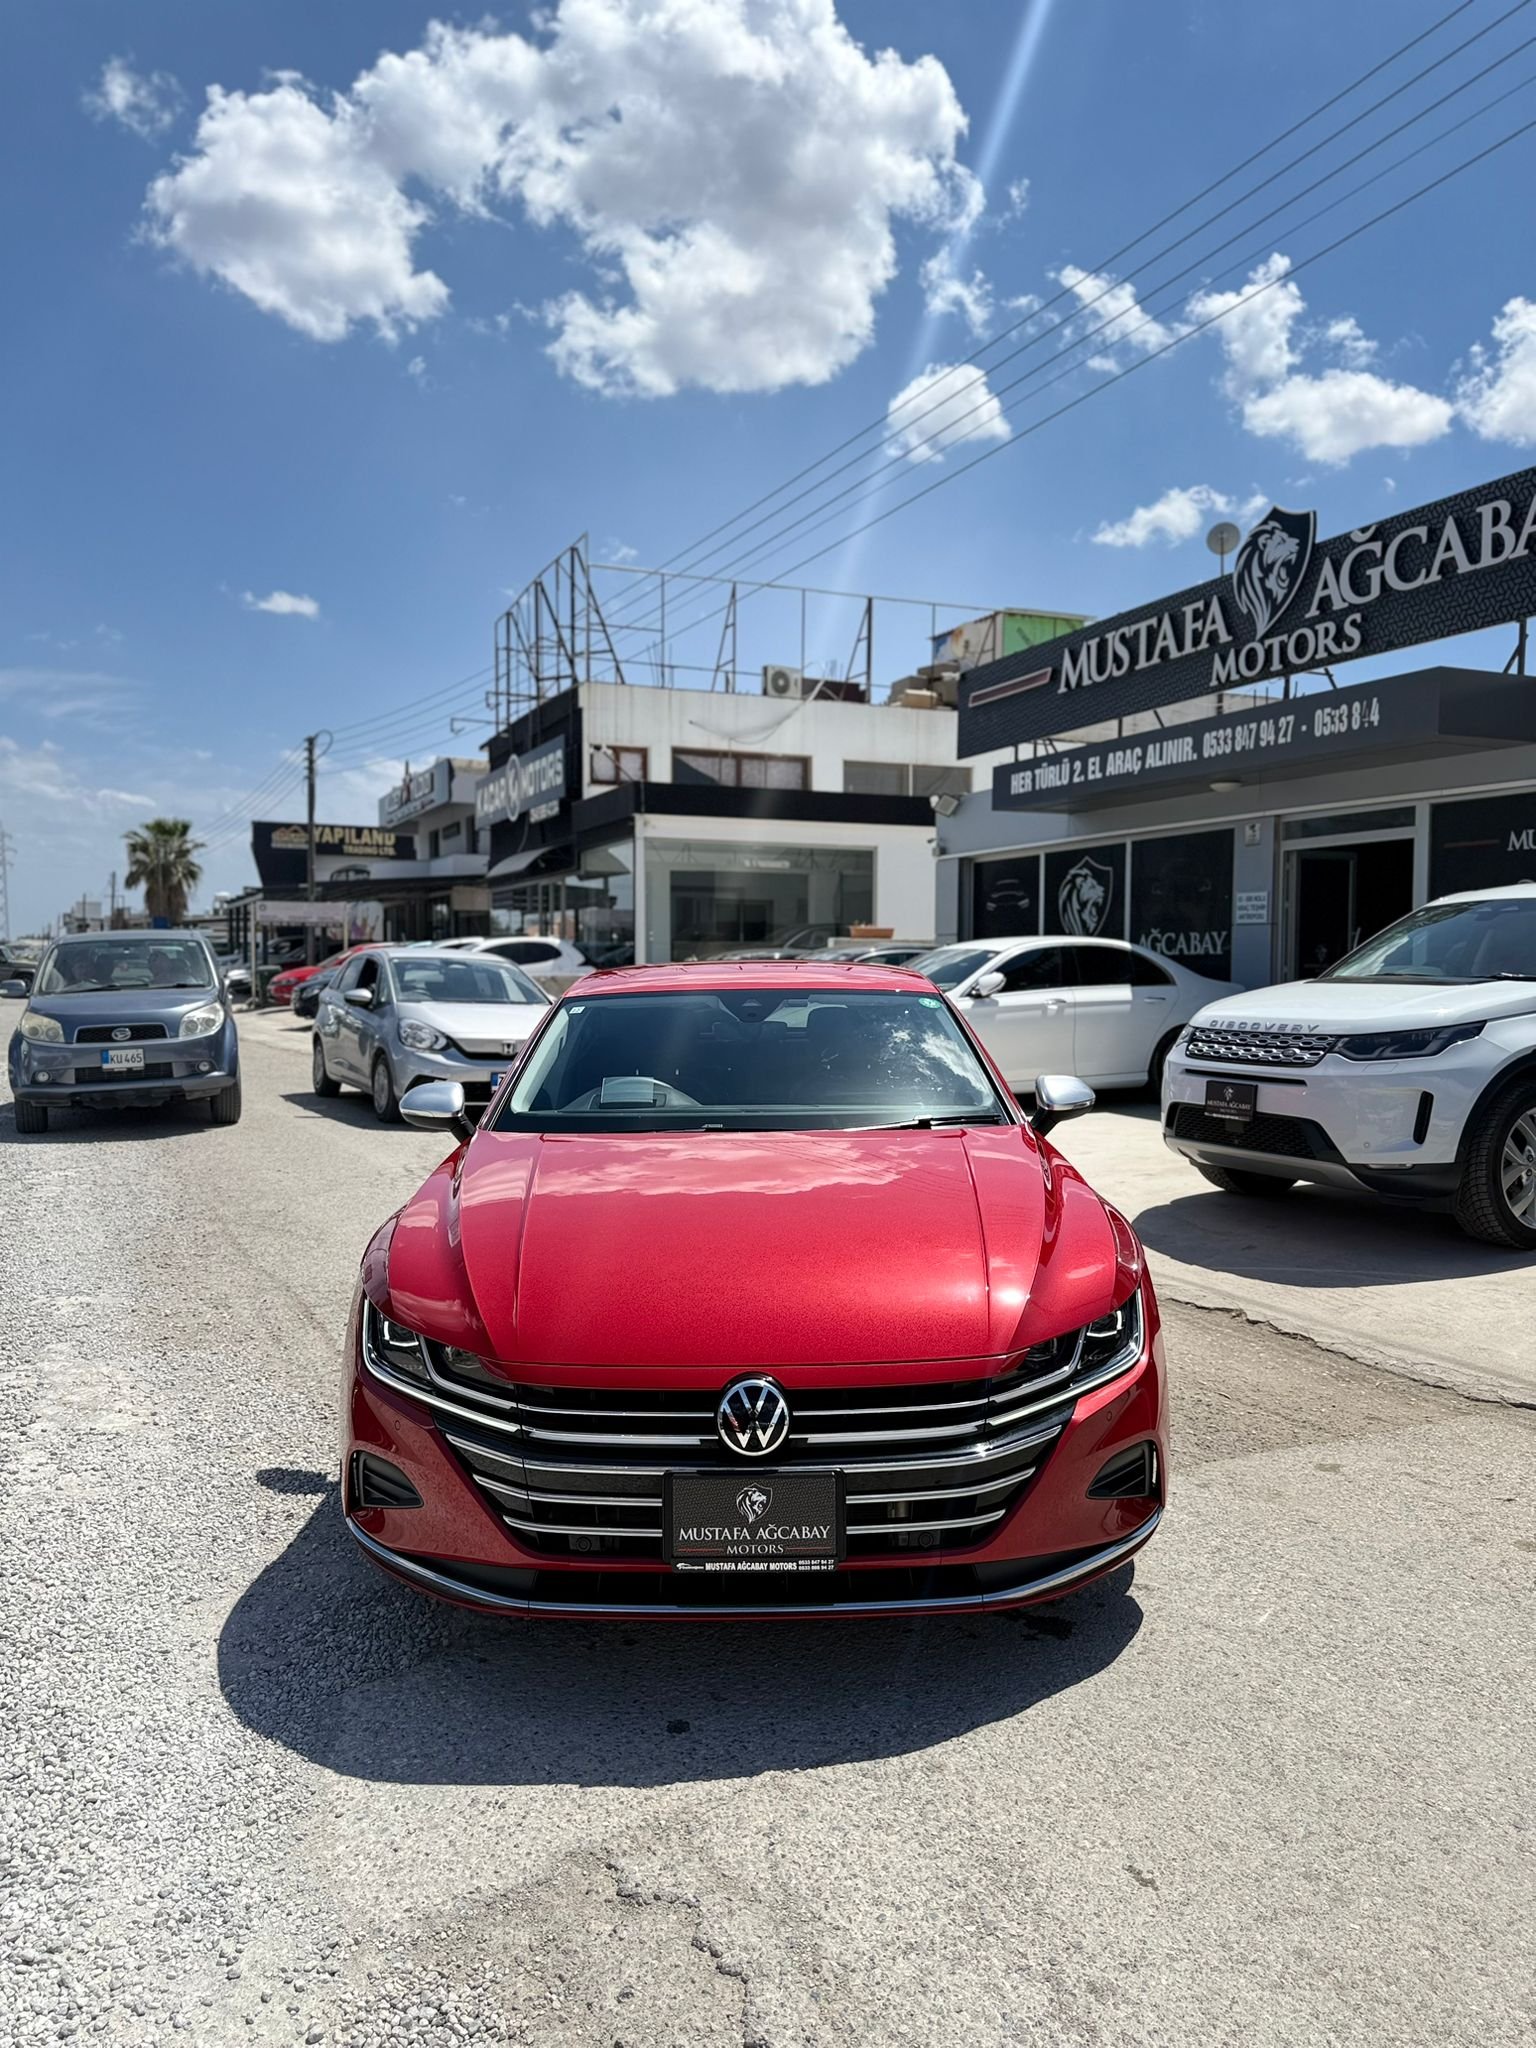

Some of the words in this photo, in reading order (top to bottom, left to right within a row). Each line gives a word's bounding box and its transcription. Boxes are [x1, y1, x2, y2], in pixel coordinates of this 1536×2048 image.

[1057, 595, 1233, 694] MUSTAFA
[1209, 613, 1364, 687] MOTORS
[1011, 773, 1033, 795] HER
[1034, 758, 1070, 790] TÜRLÜ
[1073, 764, 1085, 783] 2.
[1087, 761, 1103, 780] EL
[1105, 749, 1142, 777] ARAÇ
[1202, 728, 1232, 759] 0533
[1235, 722, 1256, 751] 847
[1259, 719, 1276, 747] 94
[1278, 715, 1295, 744] 27
[1139, 928, 1228, 955] AĞCABAY
[1209, 1020, 1320, 1032] DISCOVERY
[110, 1054, 123, 1064] KU
[124, 1053, 143, 1064] 465
[679, 1526, 751, 1541] MUSTAFA
[755, 1524, 831, 1540] AĞCABAY
[726, 1544, 784, 1555] MOTORS
[705, 1562, 736, 1571] MUSTAFA
[737, 1560, 769, 1571] AĞCABAY
[769, 1561, 797, 1570] MOTORS
